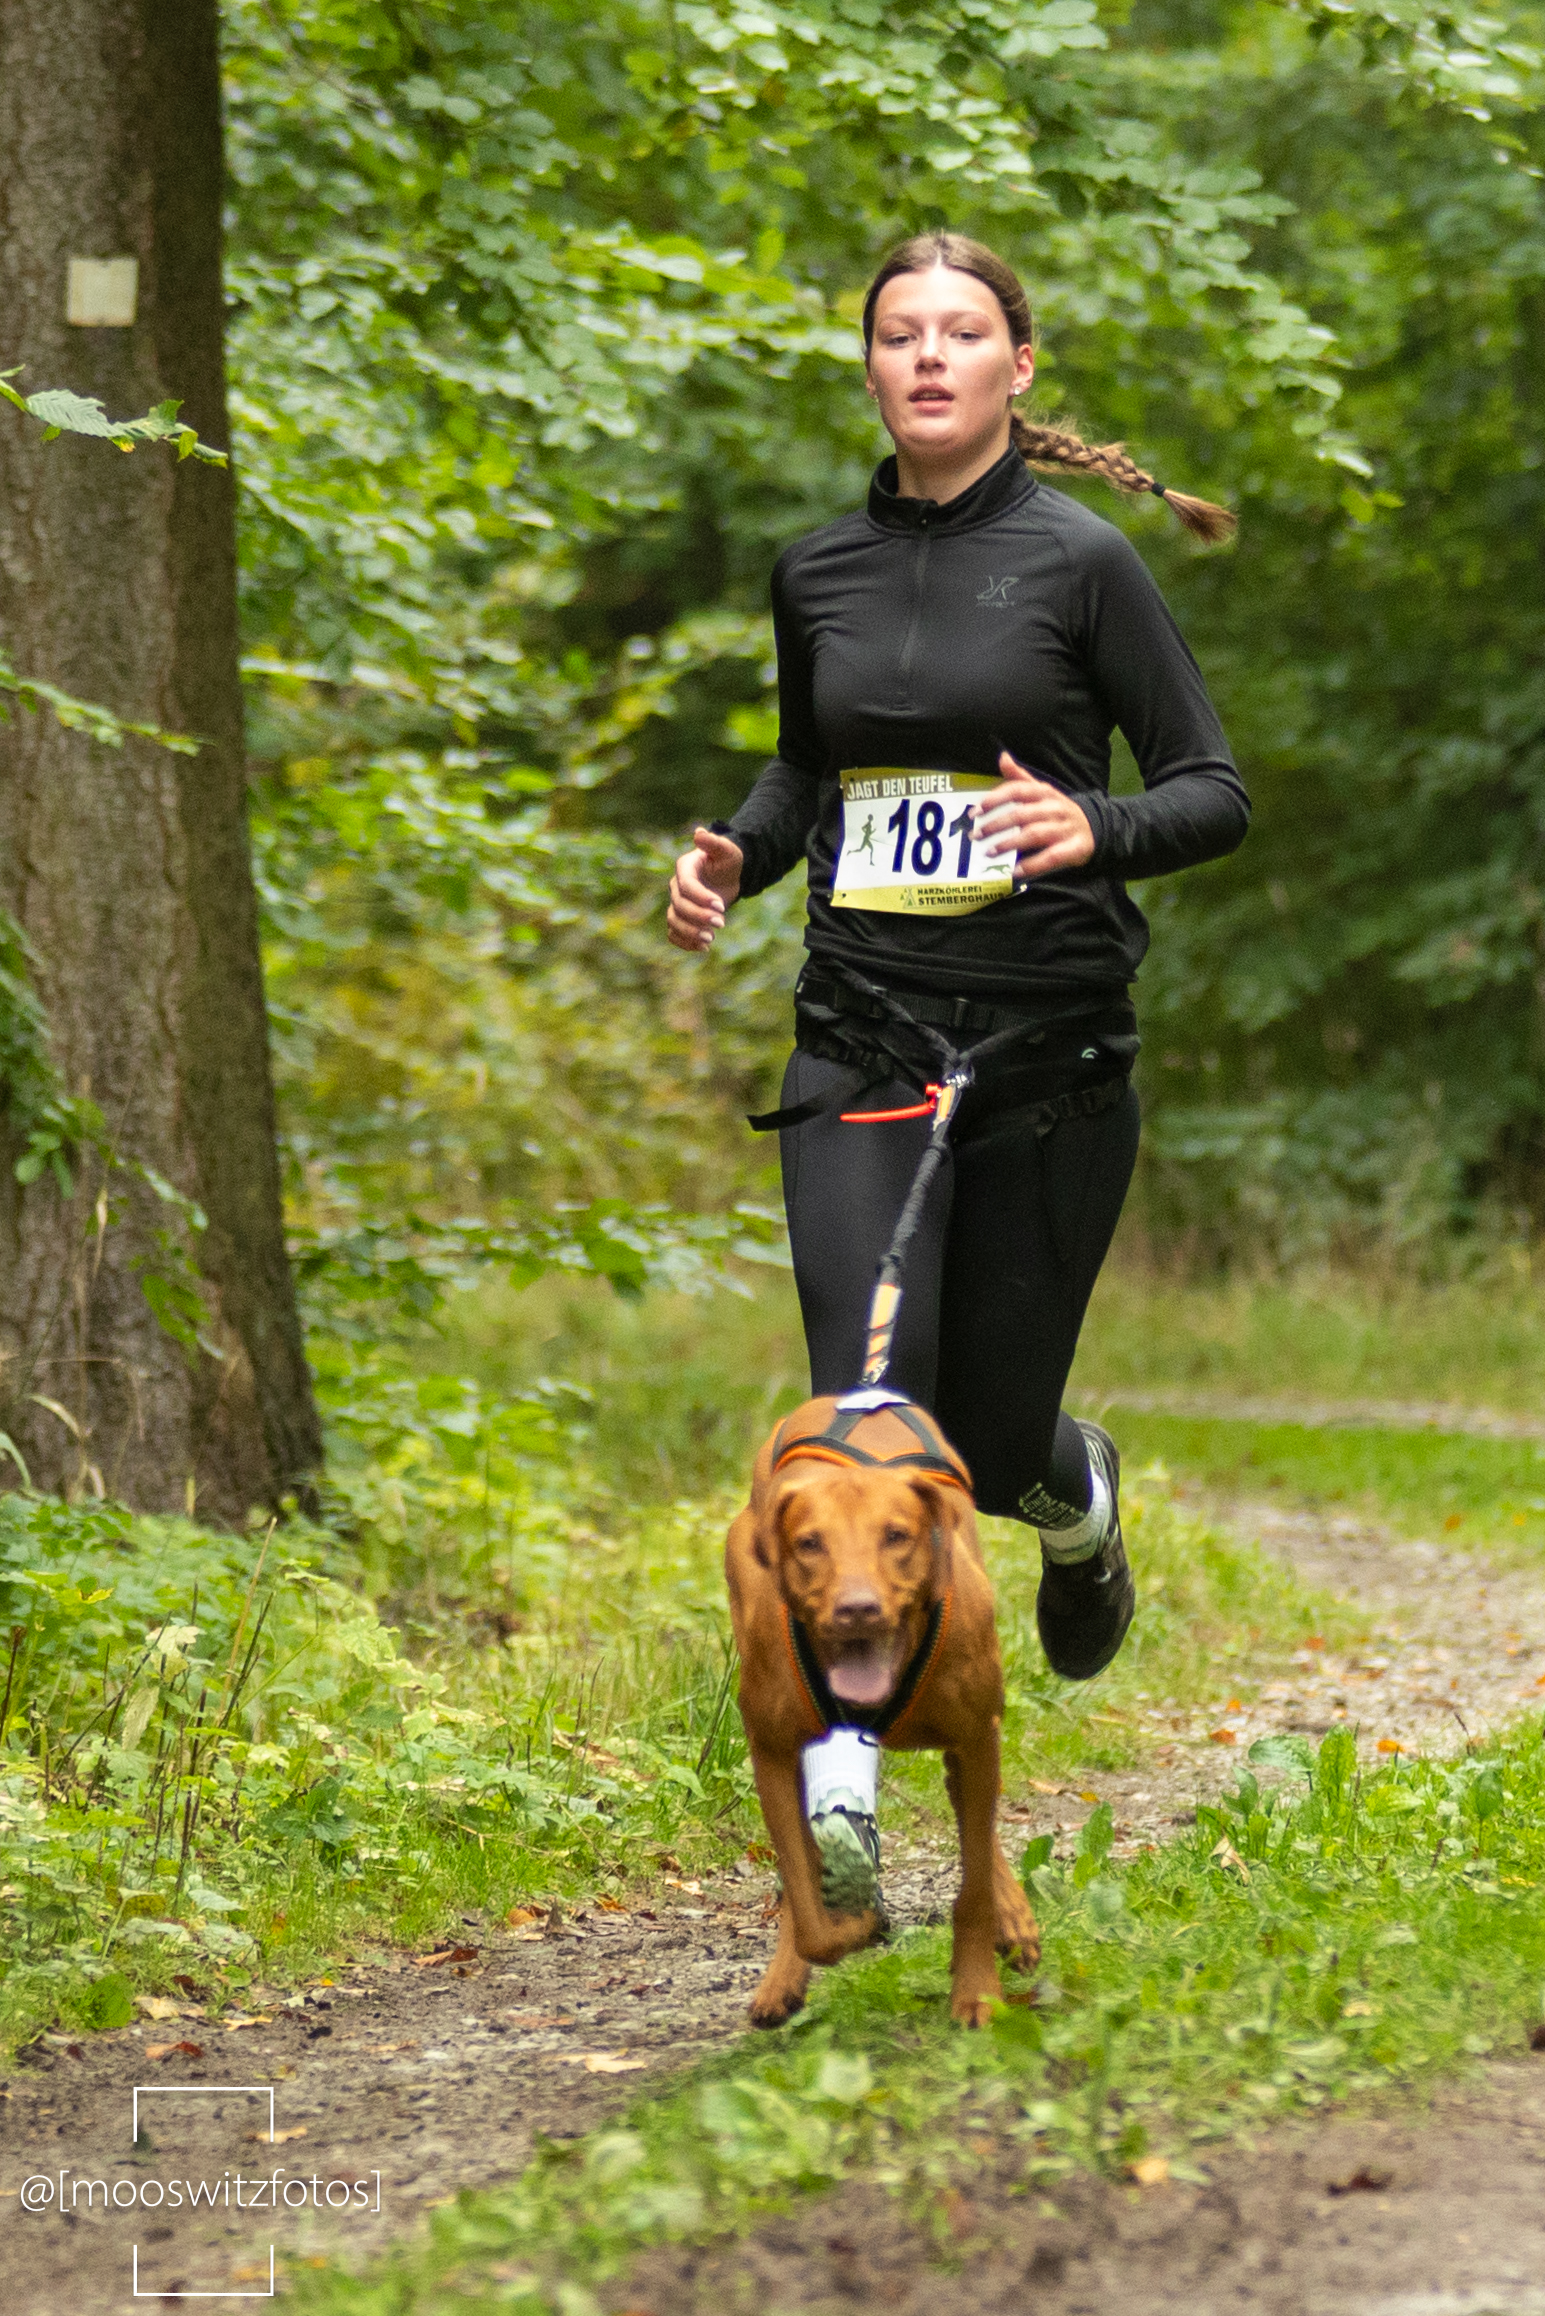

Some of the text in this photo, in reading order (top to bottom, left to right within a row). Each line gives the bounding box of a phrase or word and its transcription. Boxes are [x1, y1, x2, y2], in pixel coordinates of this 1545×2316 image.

[847, 774, 953, 800] JAGT DEN TEUFEL
[888, 798, 976, 879] 181
